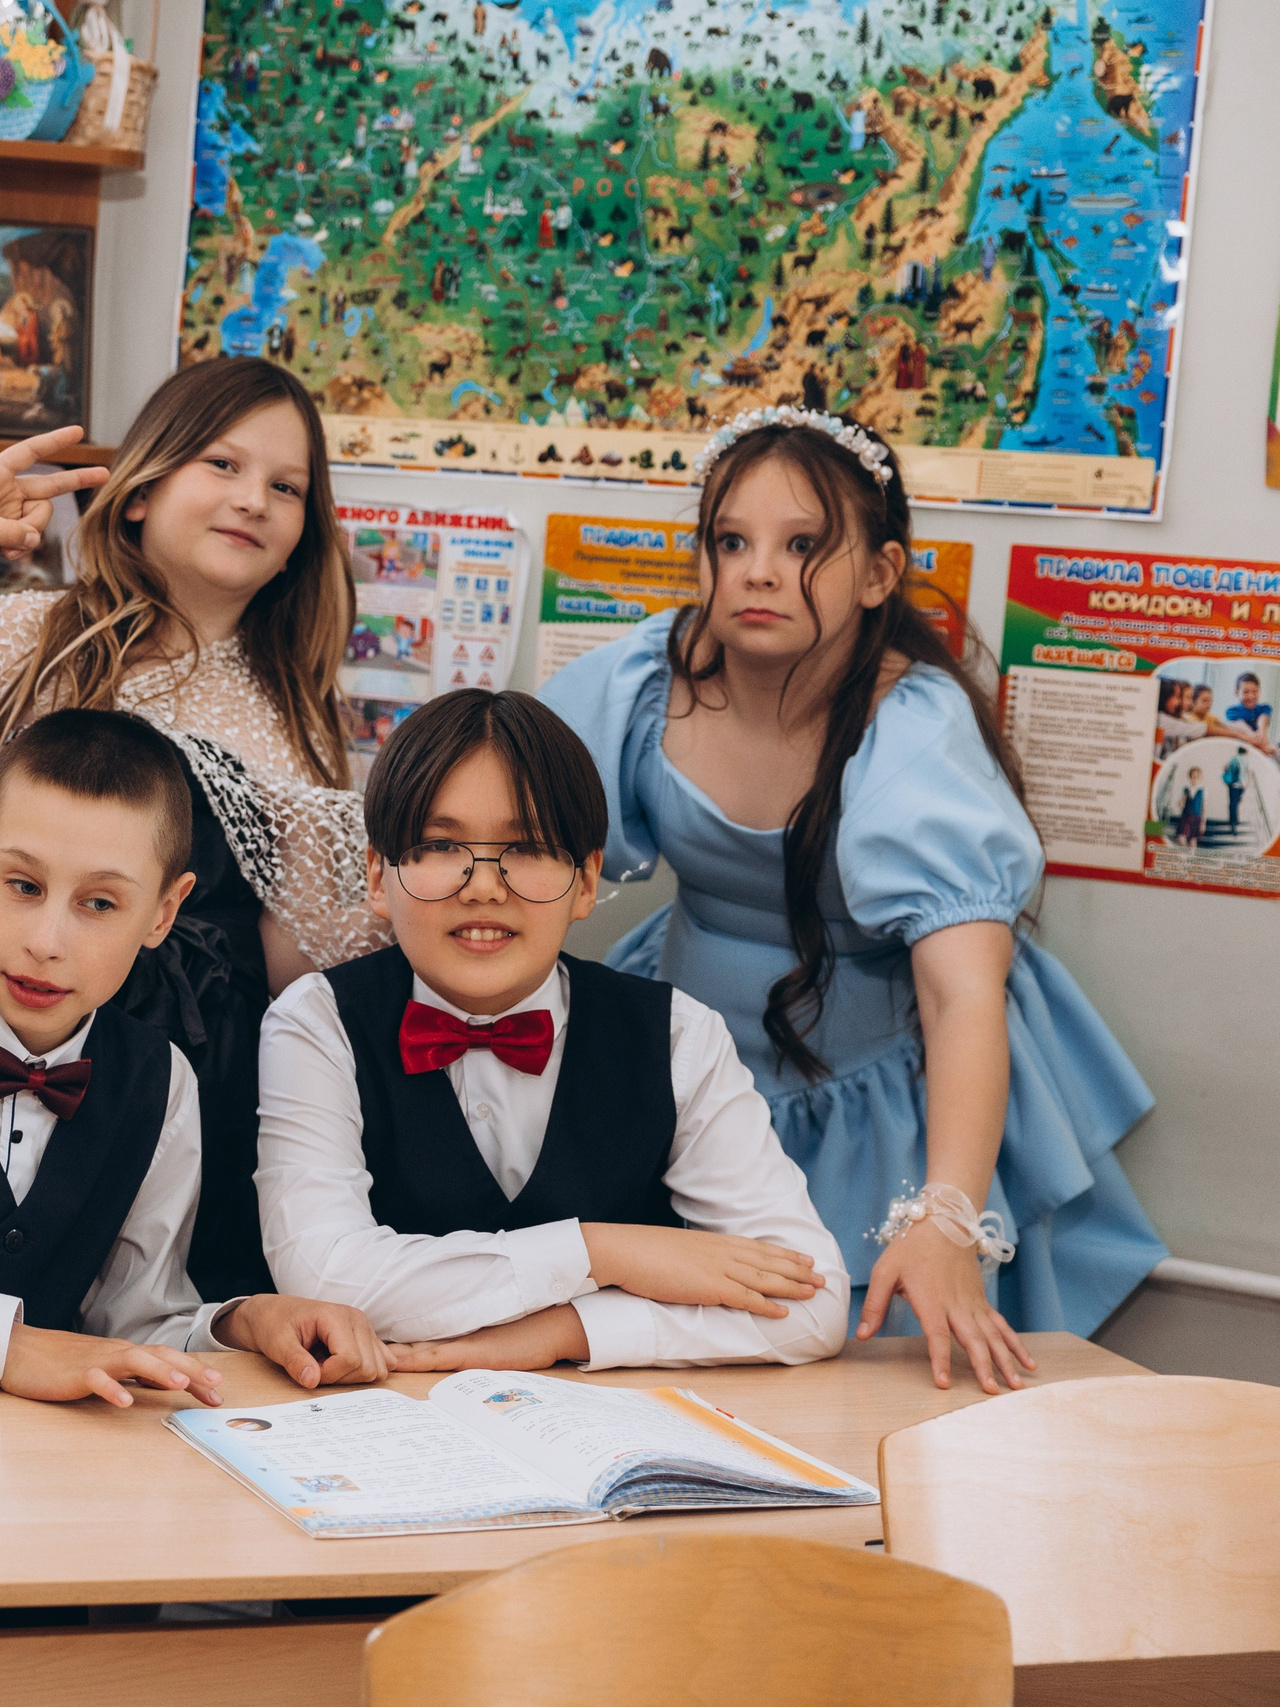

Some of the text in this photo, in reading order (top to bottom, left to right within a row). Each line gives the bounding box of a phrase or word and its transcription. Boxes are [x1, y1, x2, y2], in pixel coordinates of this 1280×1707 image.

[572, 176, 718, 198] РОССИЯ
[581, 525, 666, 550] ПРАВИЛА
[1036, 556, 1280, 595] ПРАВИЛА ПОВЕДЕНИ
[1088, 590, 1213, 619] КОРИДОРЫ
[1230, 600, 1251, 622] И
